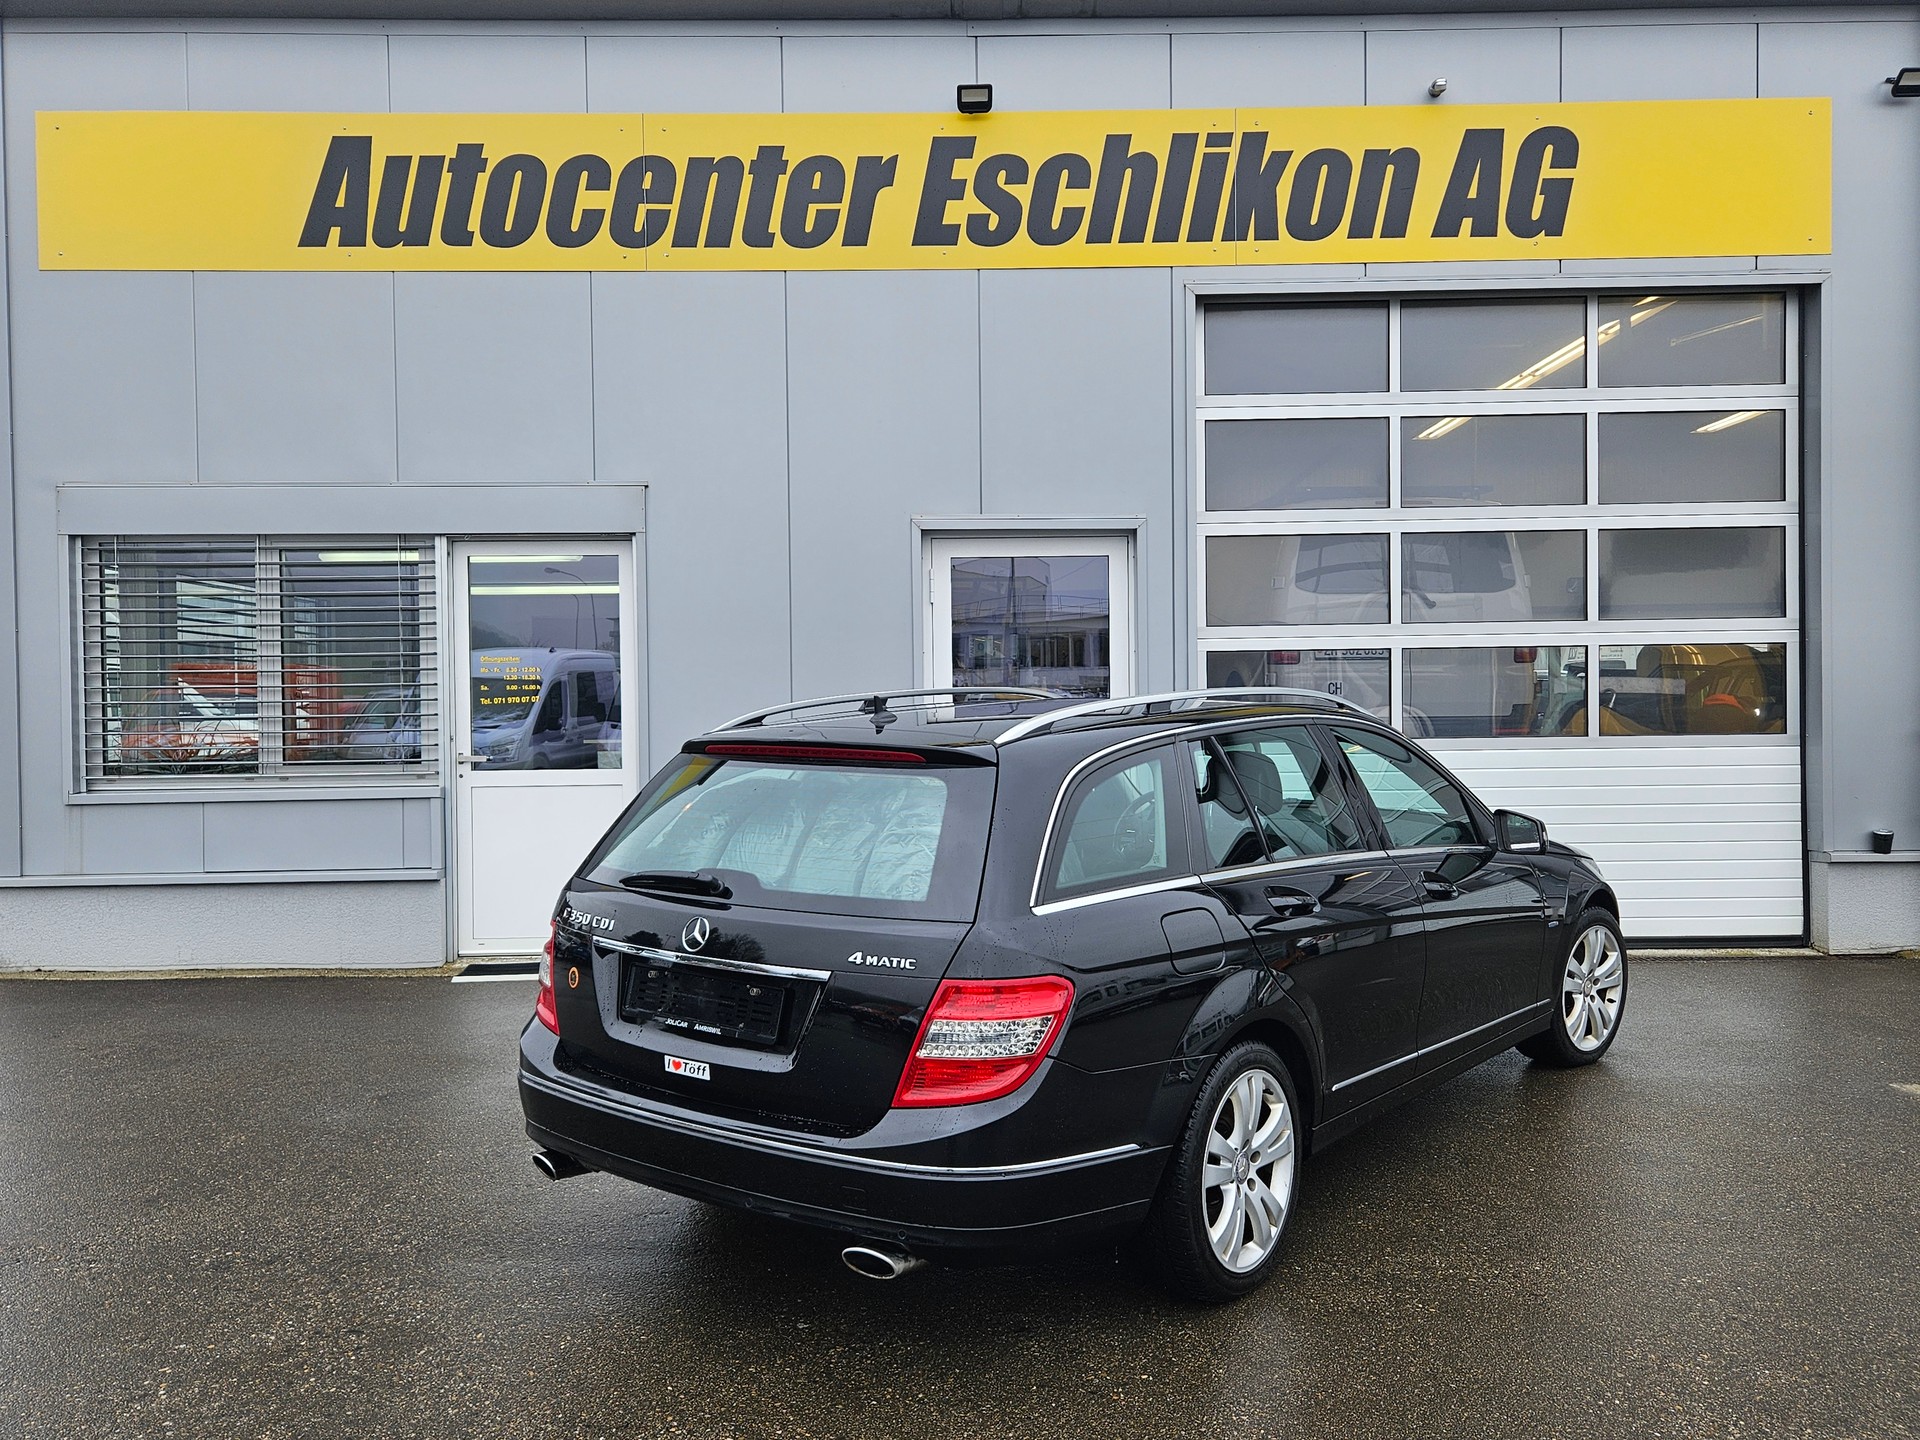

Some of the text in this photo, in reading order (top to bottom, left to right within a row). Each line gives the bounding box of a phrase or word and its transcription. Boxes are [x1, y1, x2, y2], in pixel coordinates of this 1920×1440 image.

[298, 126, 1580, 249] Autocenter Eschlikon AG
[1328, 682, 1342, 695] CH
[592, 915, 615, 931] CDI
[667, 1058, 707, 1077] I Töff
